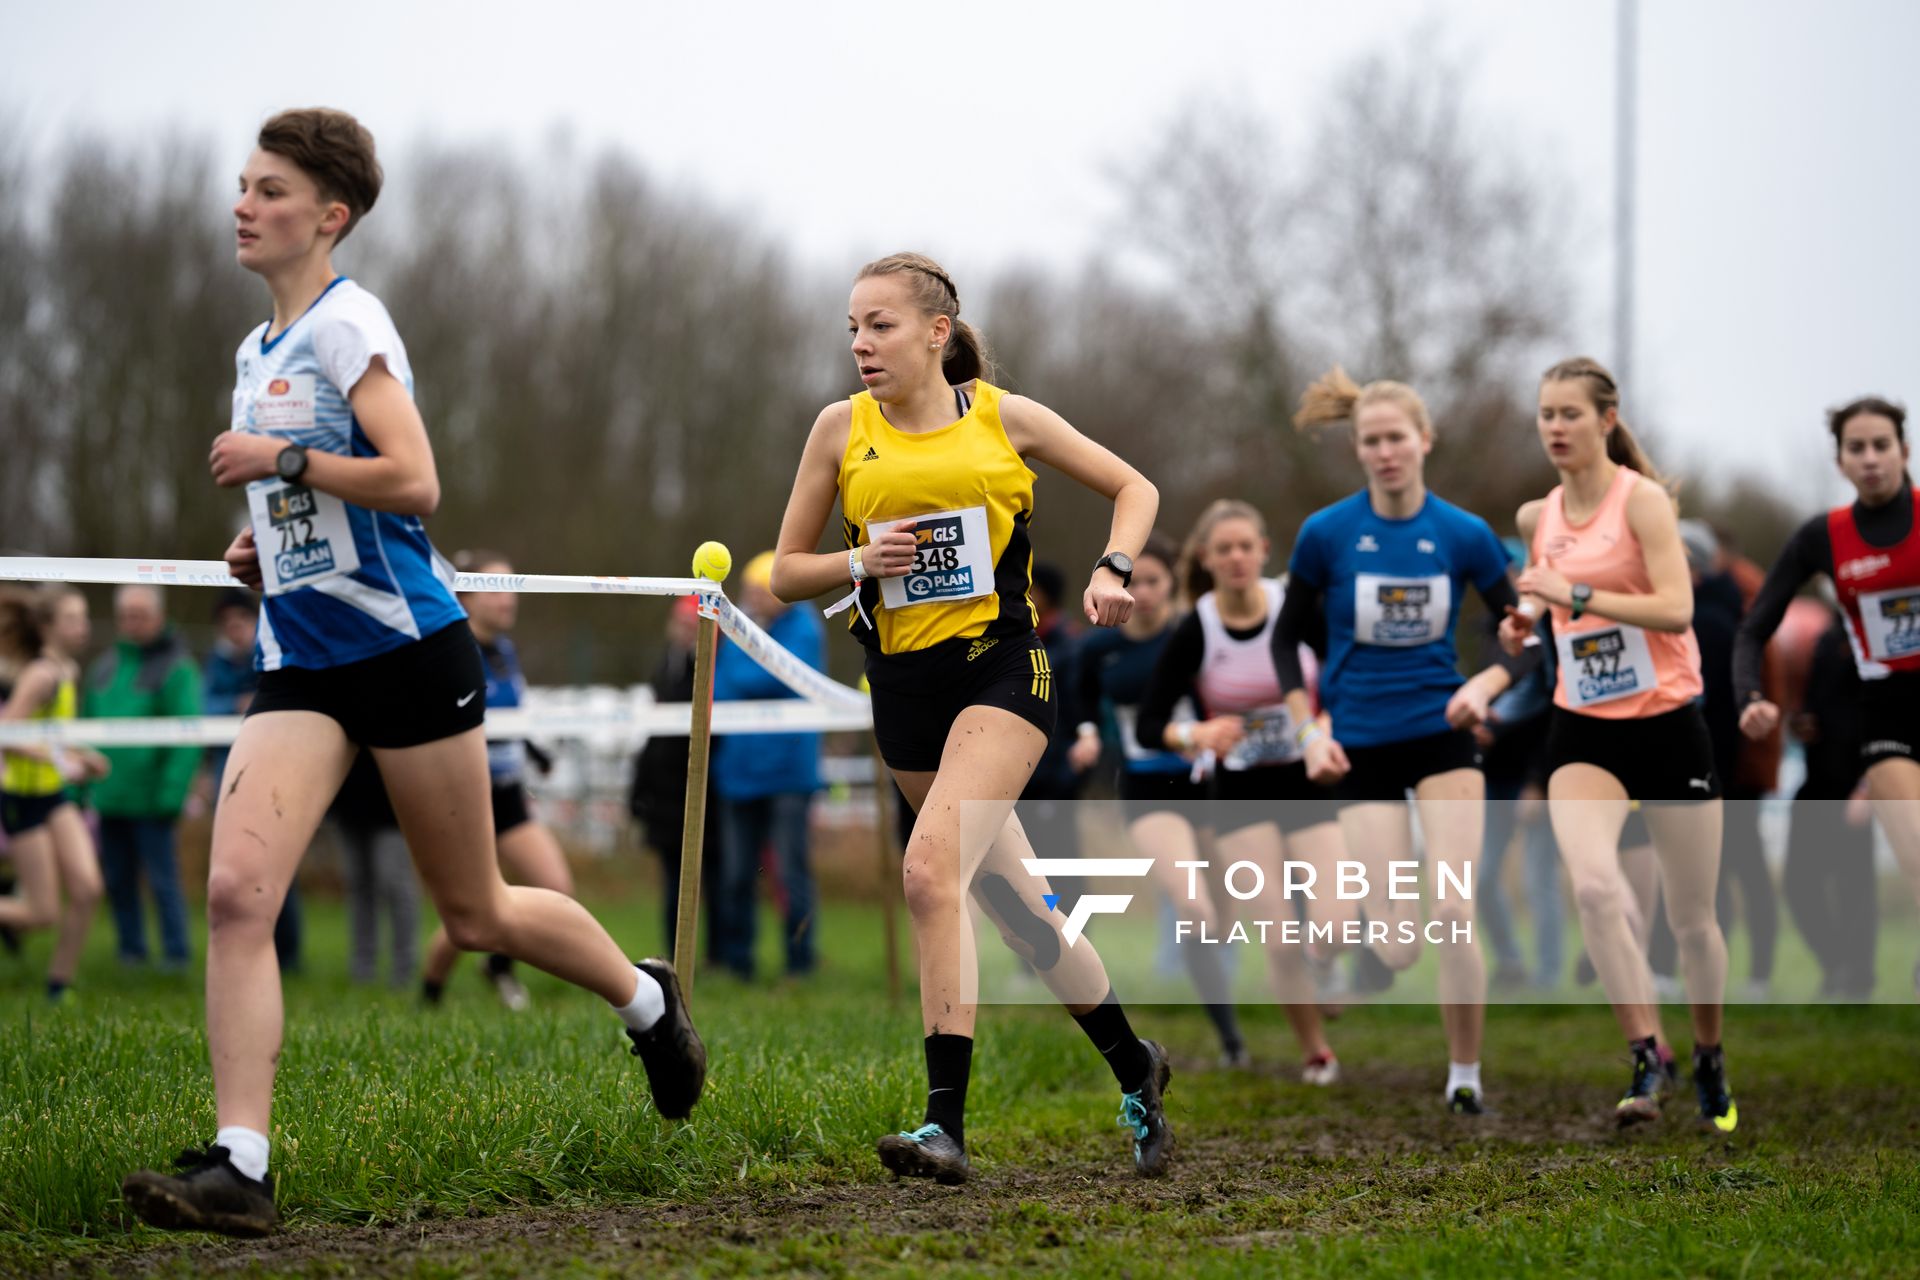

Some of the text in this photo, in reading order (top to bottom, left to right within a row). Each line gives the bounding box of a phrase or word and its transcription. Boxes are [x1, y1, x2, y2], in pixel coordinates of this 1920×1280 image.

[276, 517, 318, 553] 712
[933, 526, 957, 543] GLS
[294, 545, 331, 567] PLAN
[911, 547, 959, 574] 348
[934, 572, 970, 587] PLAN
[967, 638, 999, 661] adidas
[1582, 652, 1620, 681] 427
